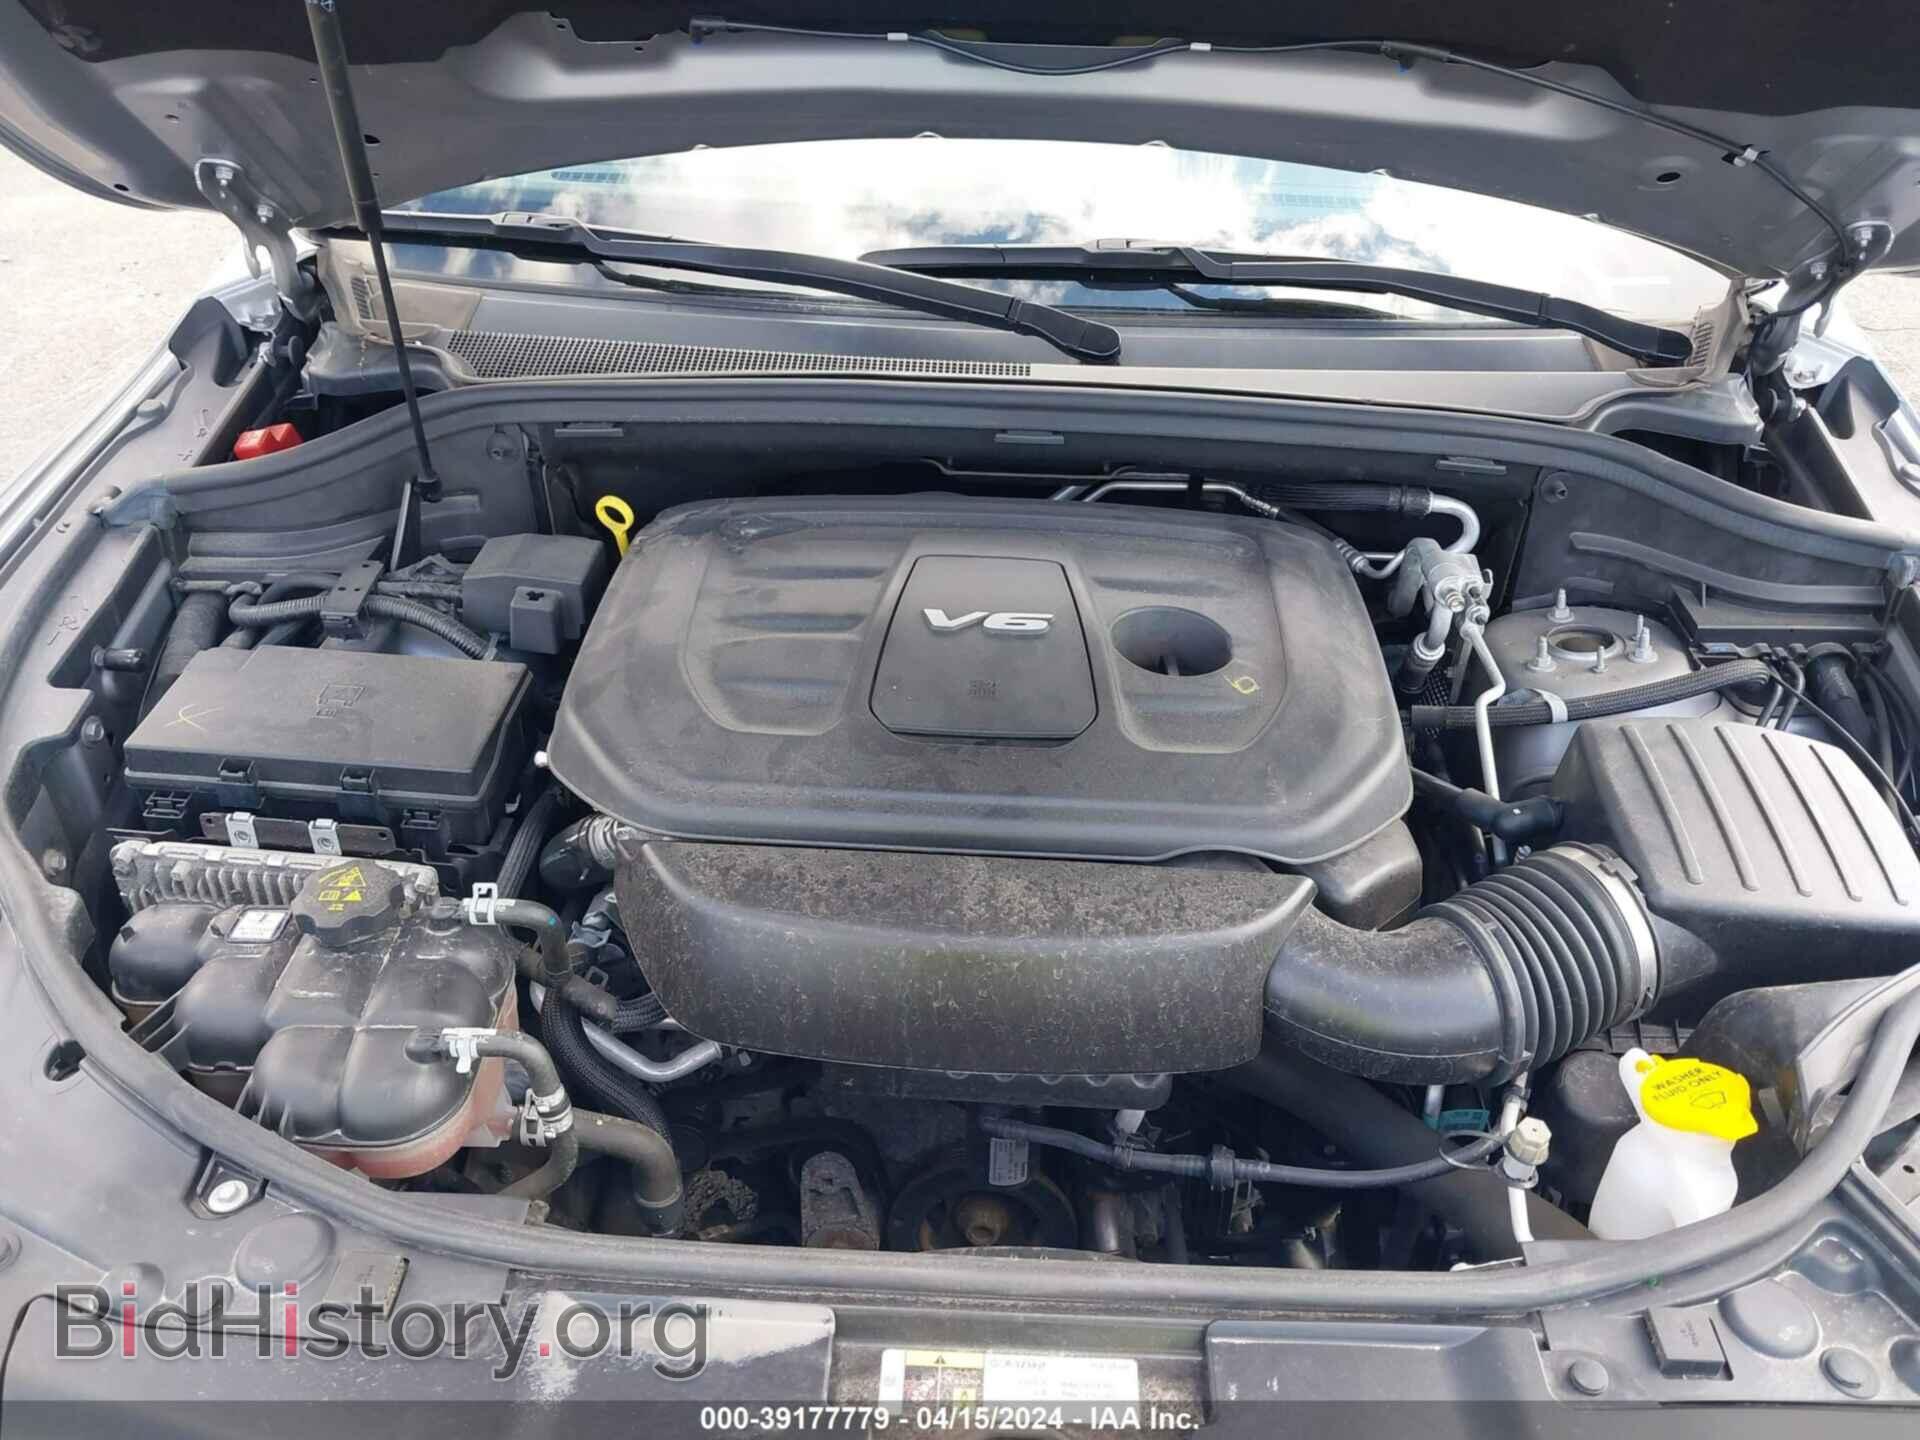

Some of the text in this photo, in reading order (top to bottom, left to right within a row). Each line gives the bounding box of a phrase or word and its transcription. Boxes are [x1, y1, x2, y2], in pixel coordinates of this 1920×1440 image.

[922, 608, 1055, 636] V6
[1652, 1071, 1721, 1101] FLUID ONLY
[1653, 1068, 1703, 1090] WASHER
